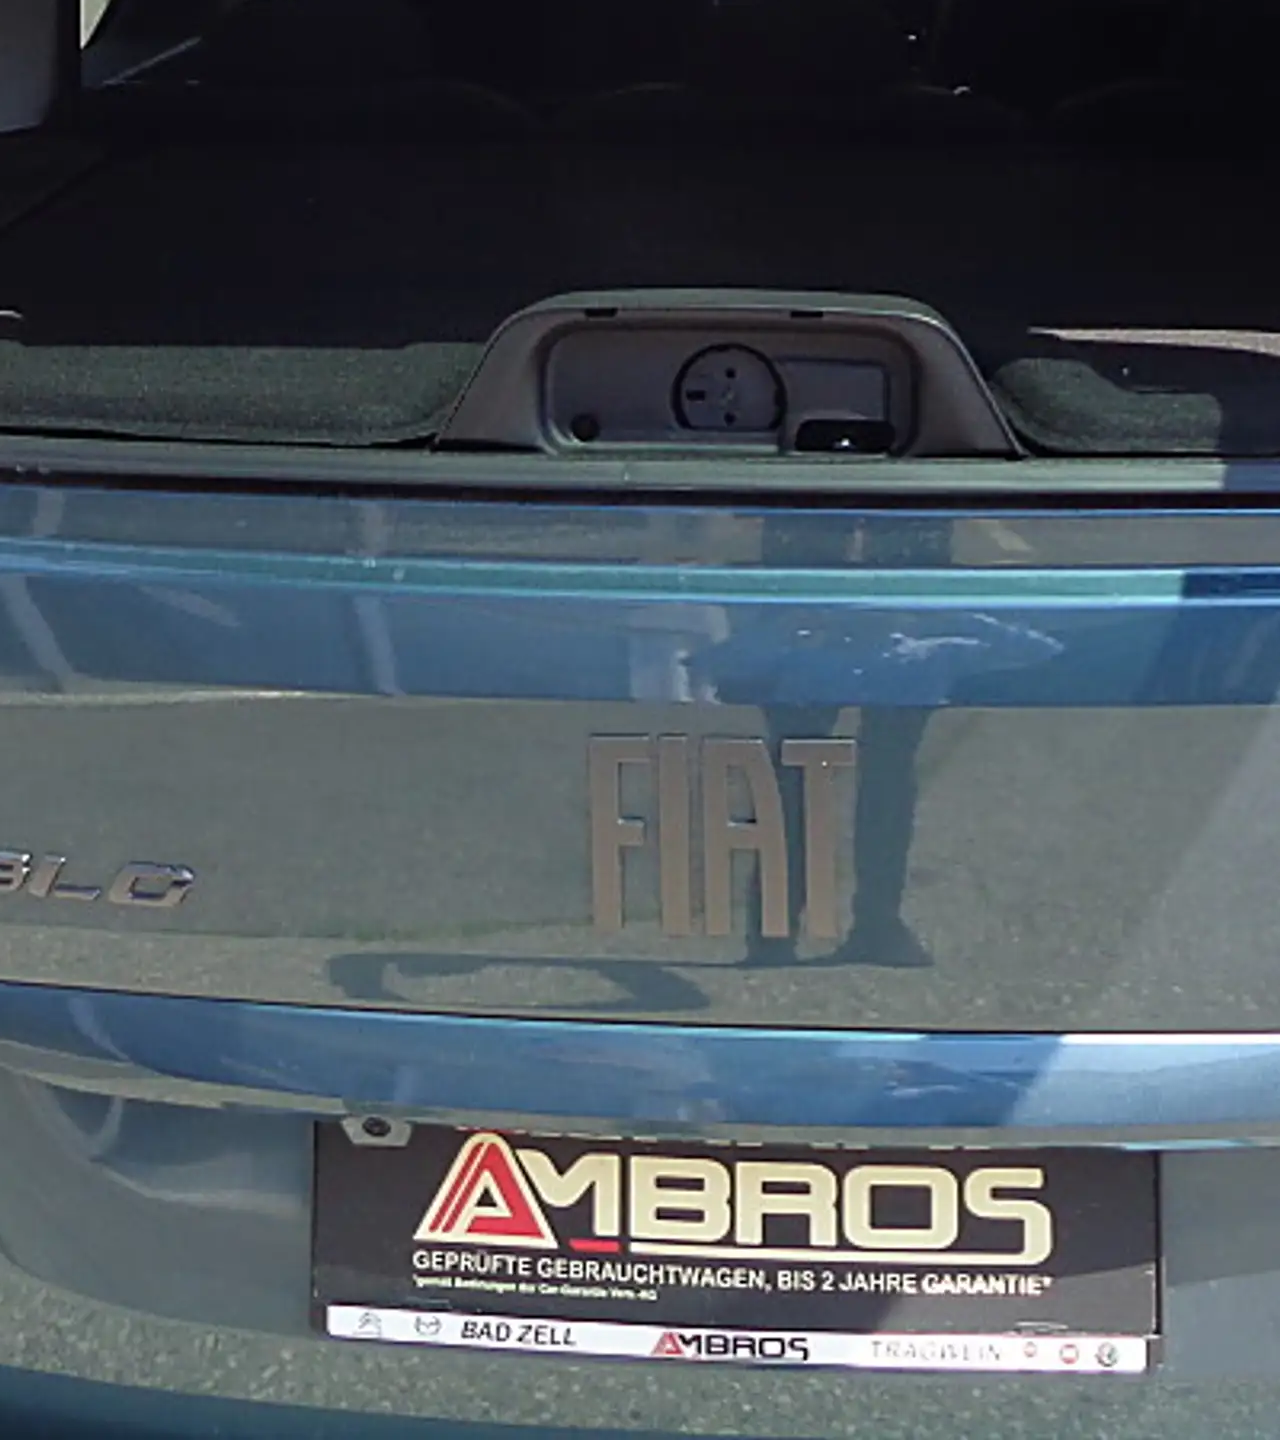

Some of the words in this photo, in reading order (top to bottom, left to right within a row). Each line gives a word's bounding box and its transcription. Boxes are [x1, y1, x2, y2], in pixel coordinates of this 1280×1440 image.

[588, 733, 857, 937] FIAT
[412, 1130, 1054, 1266] AMBROS
[412, 1249, 533, 1278] GEPRÜFTE
[537, 1258, 772, 1293] GEBRAUCHTWAGEN,
[777, 1268, 816, 1291] BIS
[820, 1271, 835, 1291] 2
[839, 1272, 918, 1294] JAHRE
[460, 1320, 512, 1342] BAD
[516, 1324, 577, 1345] ZELL
[651, 1331, 810, 1361] AMBROS
